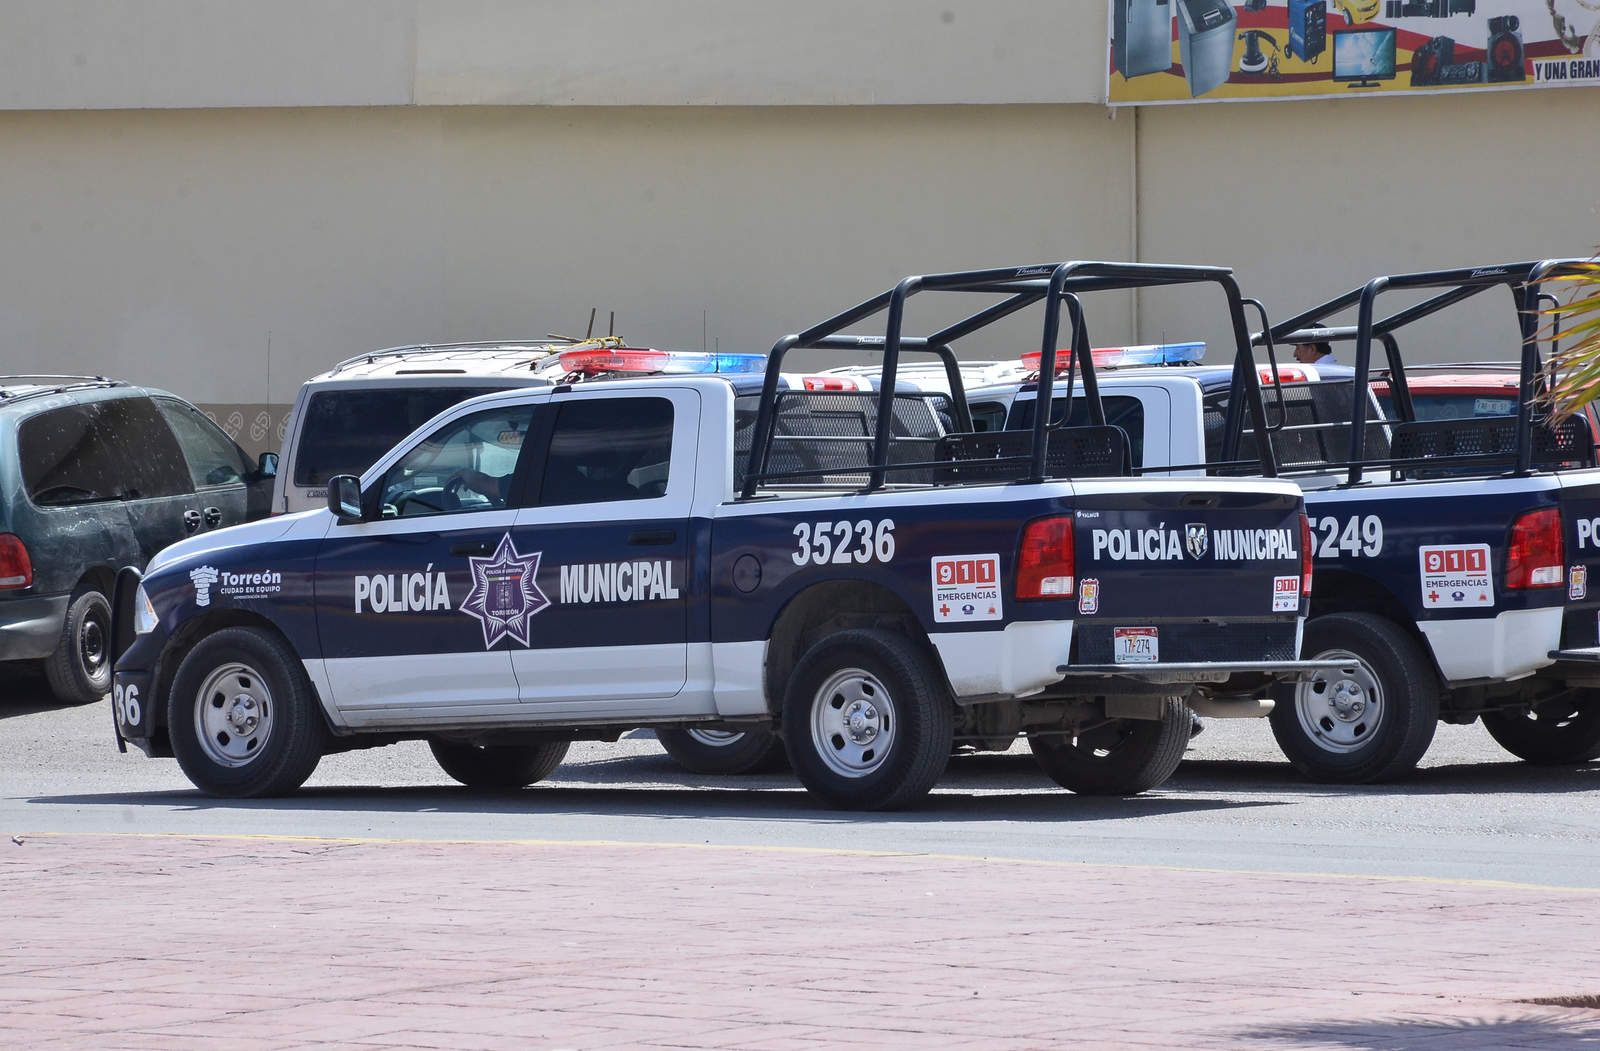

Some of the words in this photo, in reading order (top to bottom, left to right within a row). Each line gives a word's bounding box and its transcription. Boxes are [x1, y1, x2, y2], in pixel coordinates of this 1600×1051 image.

[1535, 63, 1542, 80] Y
[1545, 62, 1567, 80] UNA
[1570, 60, 1600, 78] GRAN
[791, 518, 896, 566] 35236
[1092, 521, 1184, 561] POLICÍA
[1213, 529, 1298, 560] MUNICIPAL
[1428, 552, 1481, 571] 911
[221, 569, 281, 586] Torreón
[939, 561, 990, 582] 911
[354, 563, 451, 613] POLICÍA
[560, 560, 679, 604] MUNICIPAL
[1277, 580, 1297, 591] 911
[1426, 579, 1488, 588] EMERGENCIAS
[937, 591, 997, 601] EMERGENCIAS
